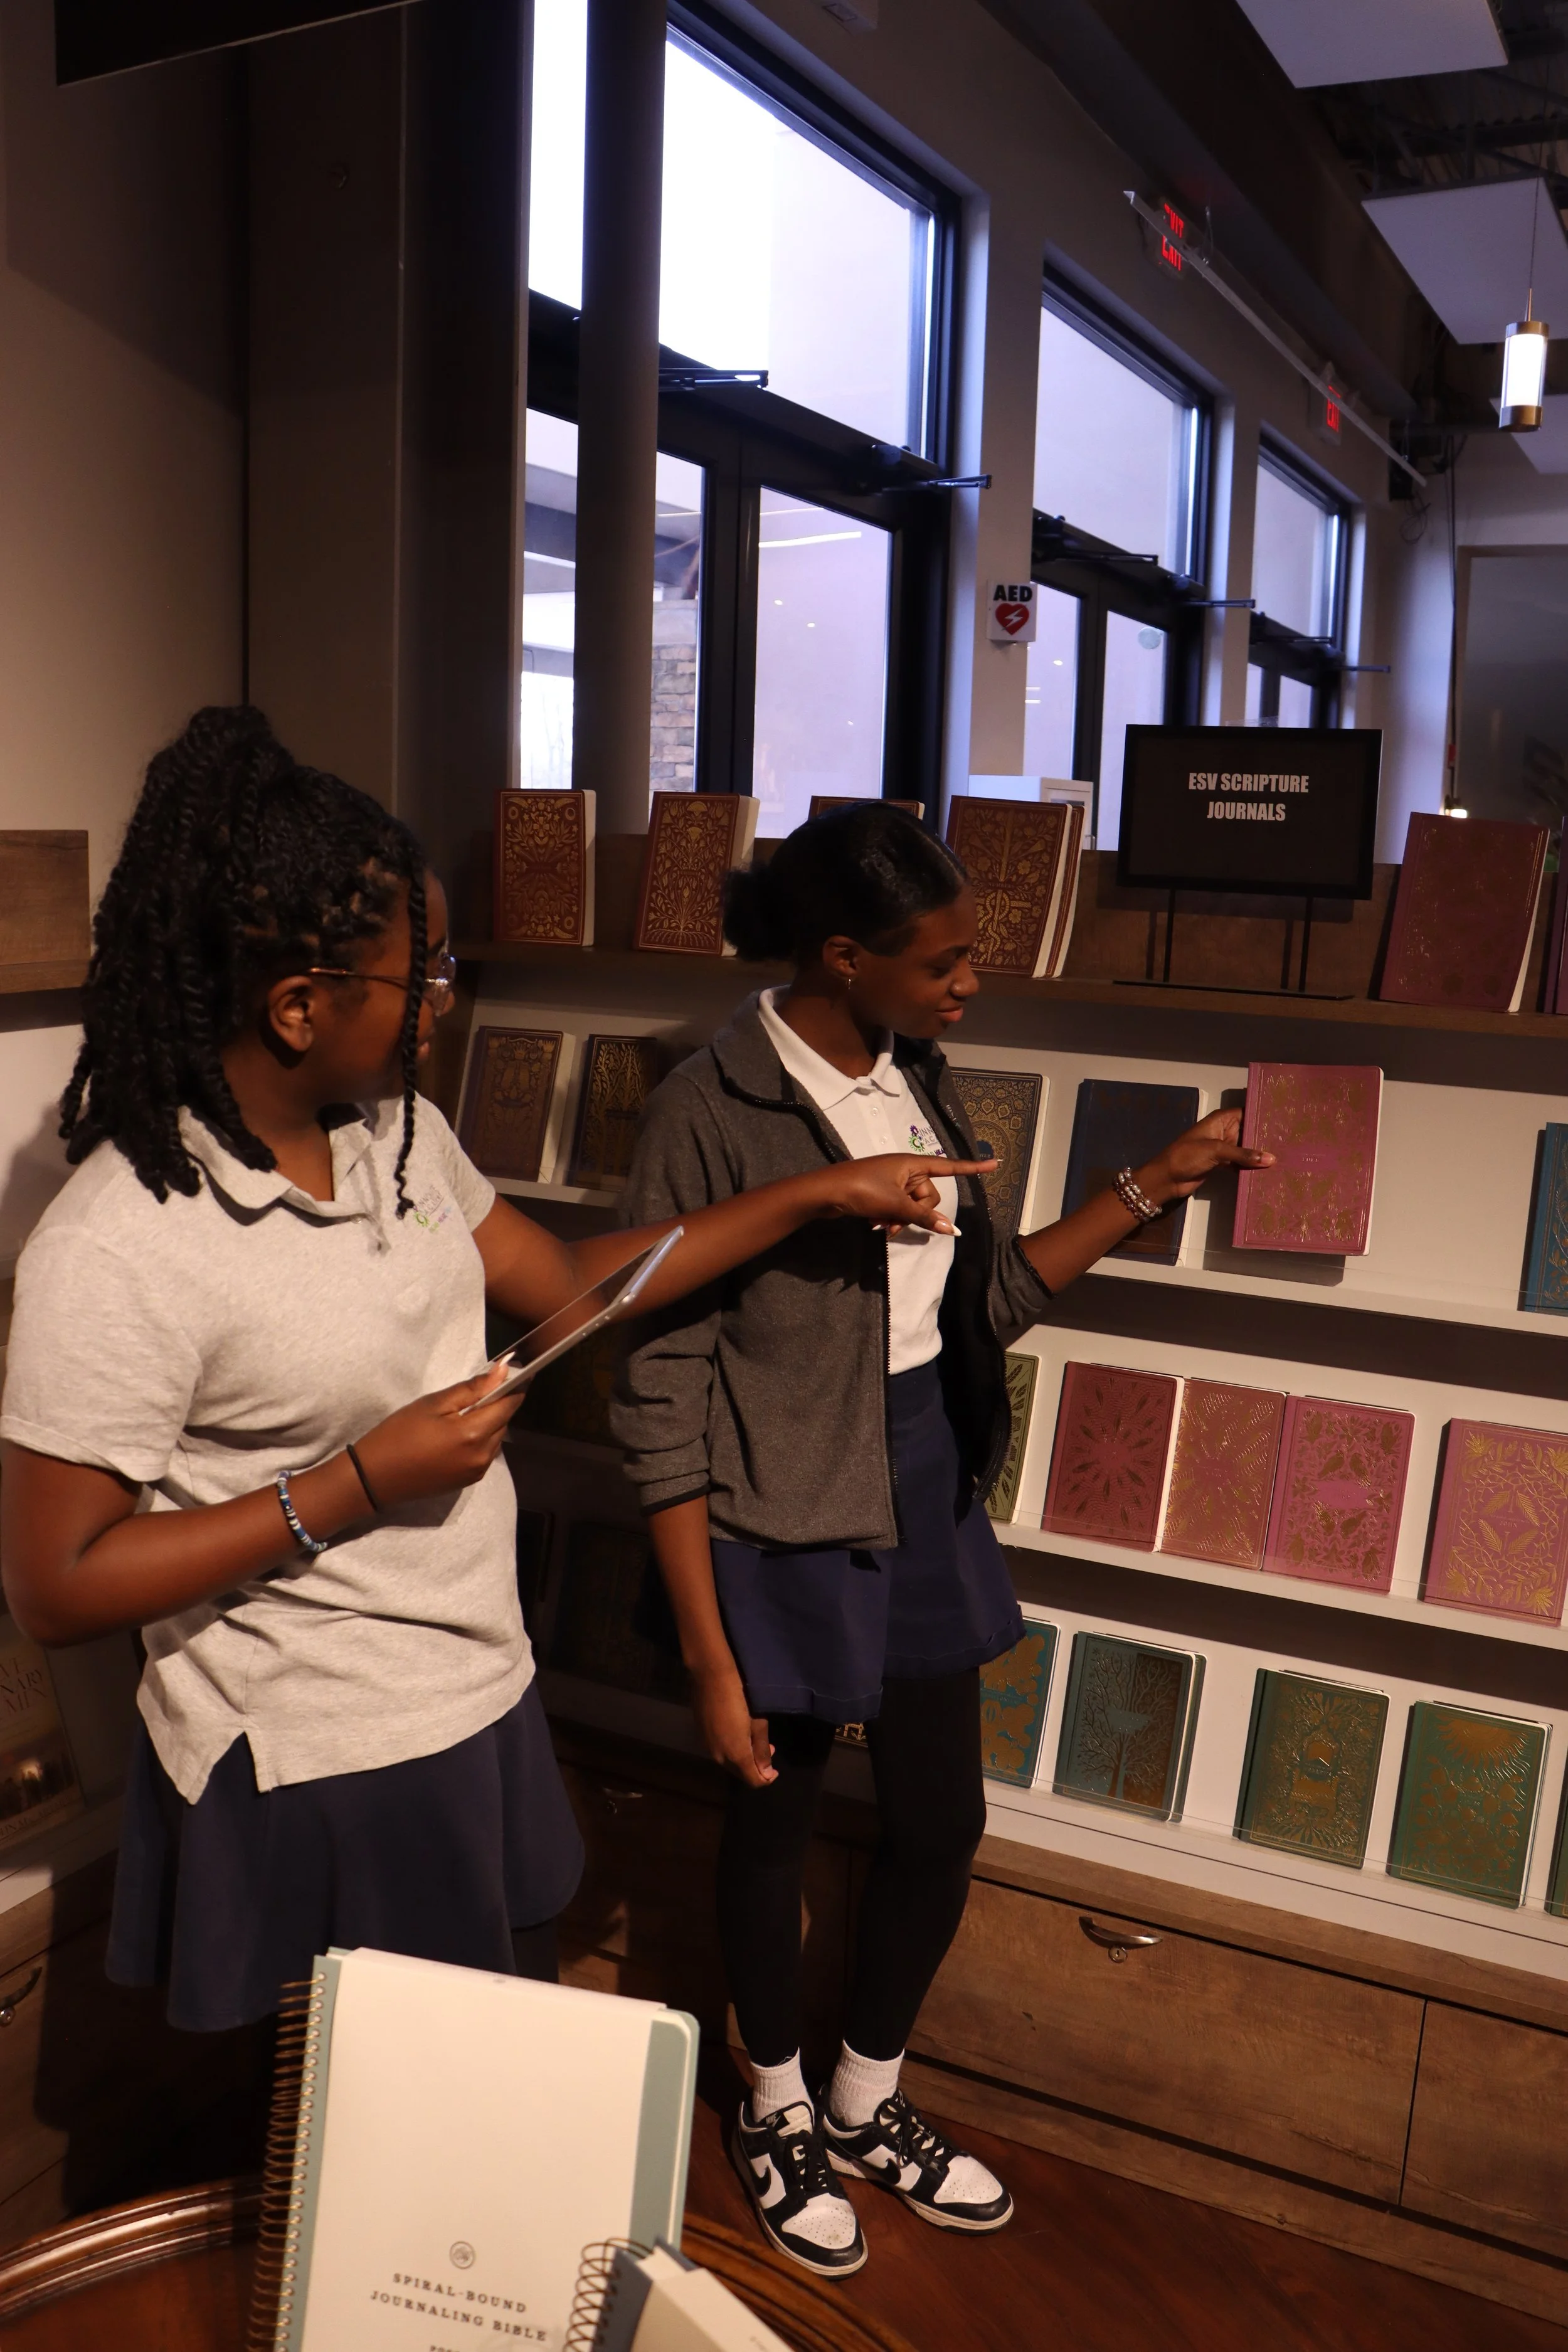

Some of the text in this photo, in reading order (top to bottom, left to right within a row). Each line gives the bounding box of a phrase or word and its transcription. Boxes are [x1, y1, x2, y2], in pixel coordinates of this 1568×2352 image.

[993, 584, 1033, 602] AED
[1189, 773, 1310, 793] ESV SCRIPTURE
[1207, 801, 1286, 821] JOURNALS
[1499, 1520, 1517, 1528] JOHN
[766, 2111, 778, 2124] NIKE
[393, 2273, 526, 2313] SPIRAL-BOUND
[370, 2291, 547, 2341] JOURNALING BIBLE
